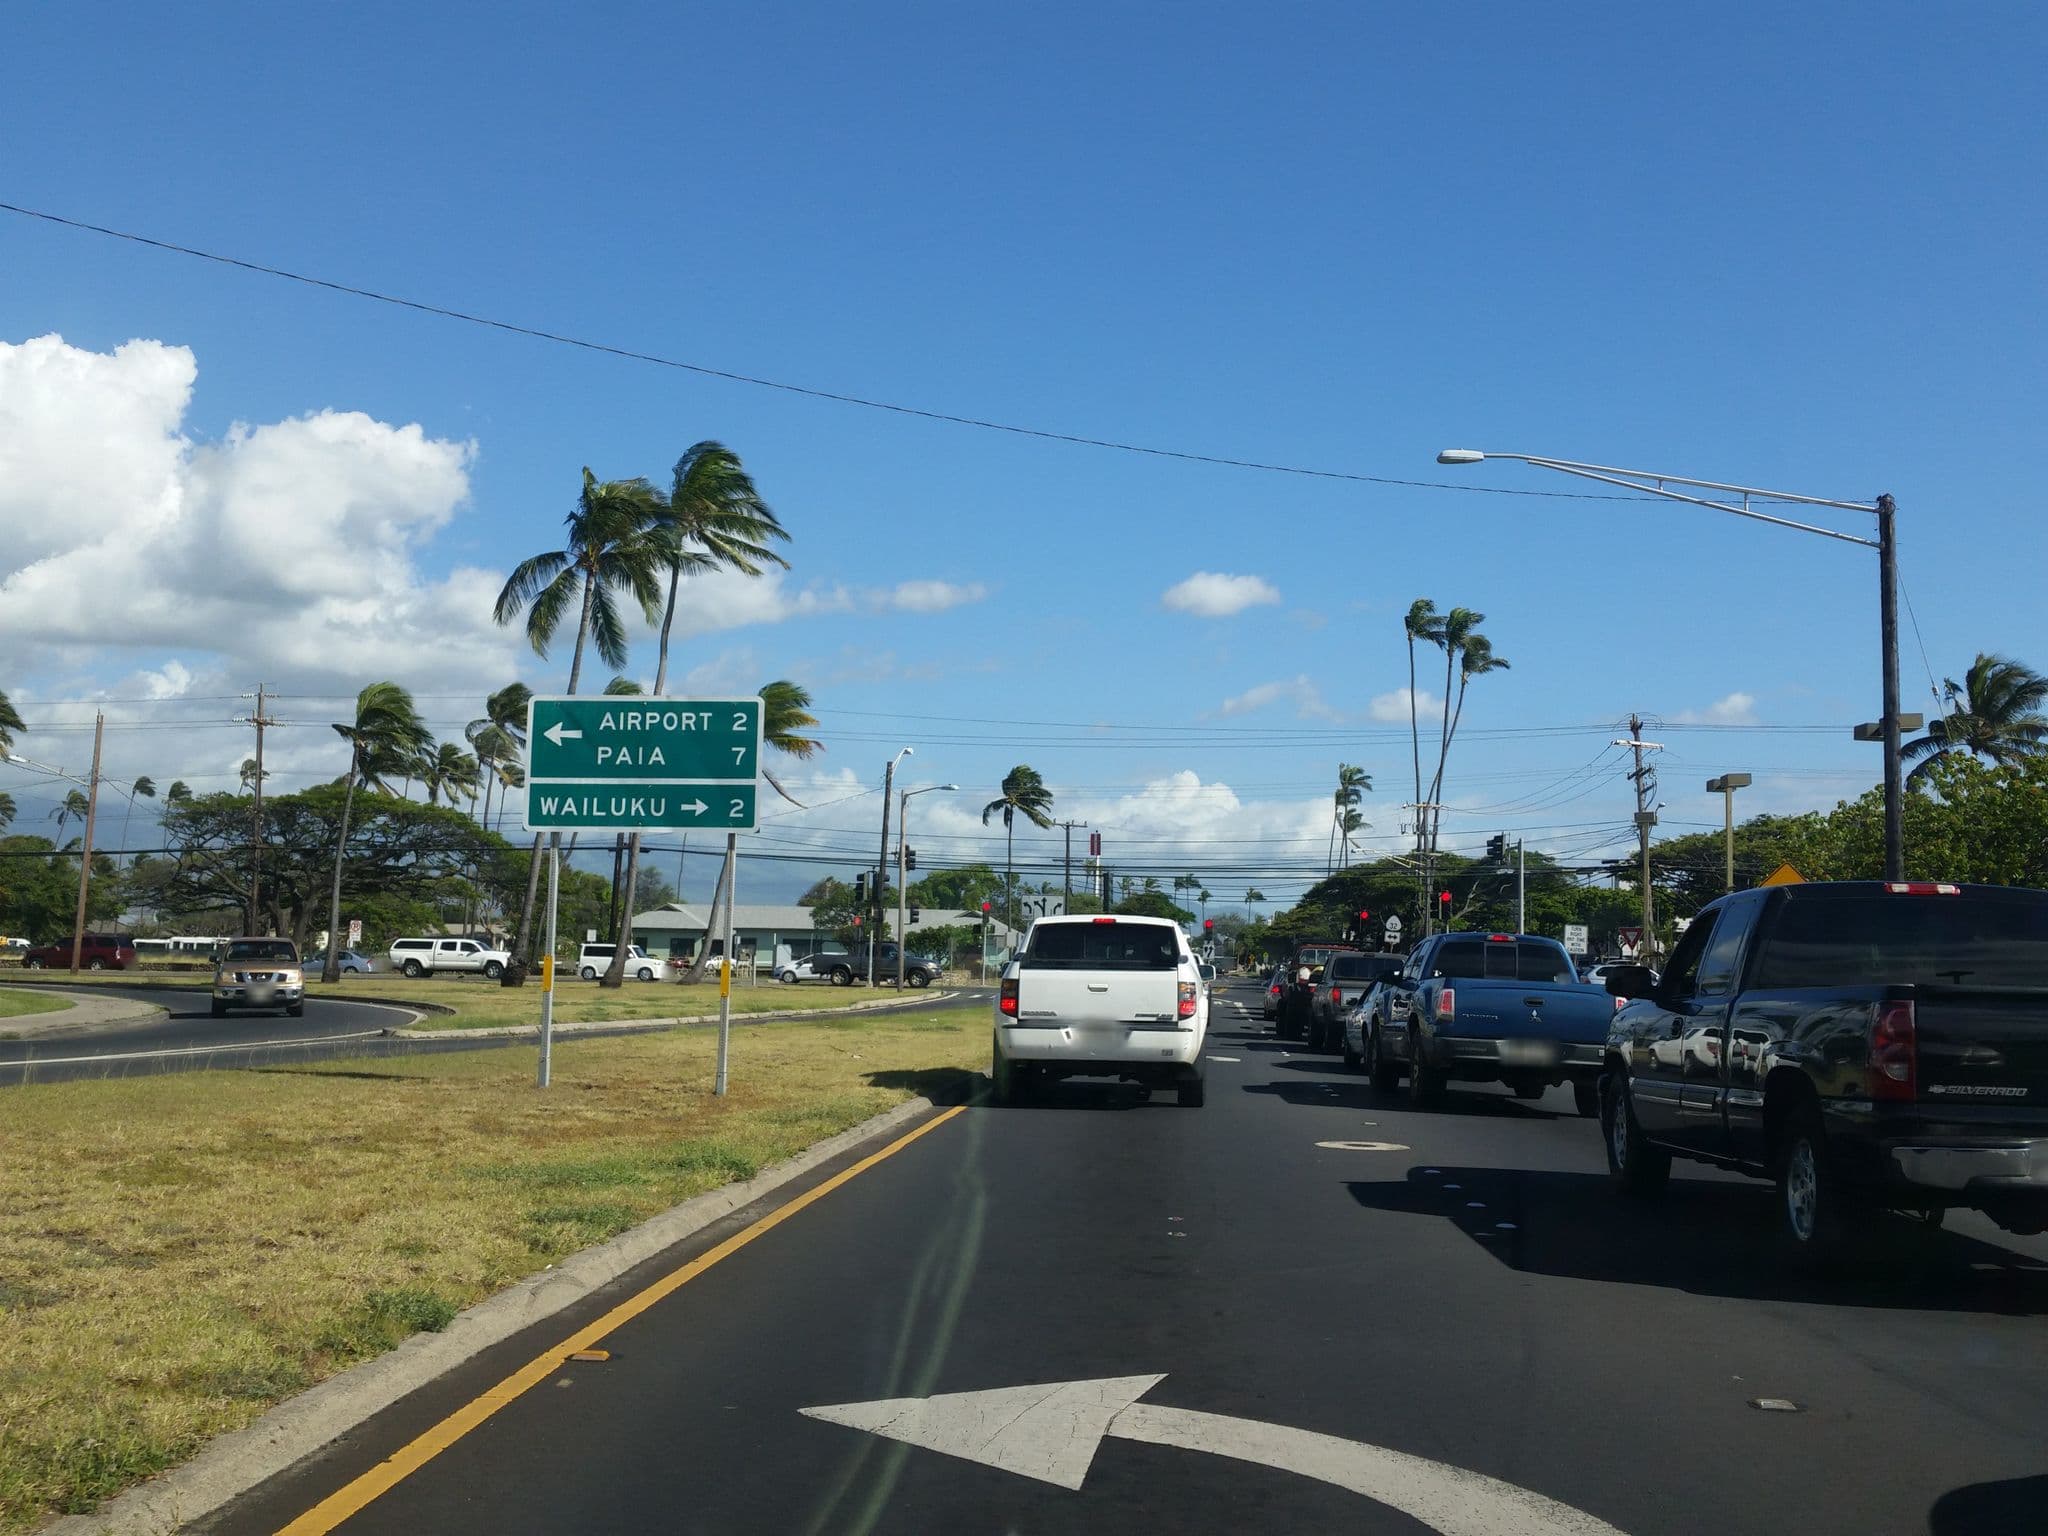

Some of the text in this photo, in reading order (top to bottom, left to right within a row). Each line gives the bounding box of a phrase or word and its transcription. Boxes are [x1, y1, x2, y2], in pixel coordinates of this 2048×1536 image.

[599, 712, 747, 731] AIRPORT 2
[597, 747, 746, 766] PAIA 7
[540, 797, 744, 818] WAILUKU 2
[1946, 1085, 2028, 1096] SILVERADO
